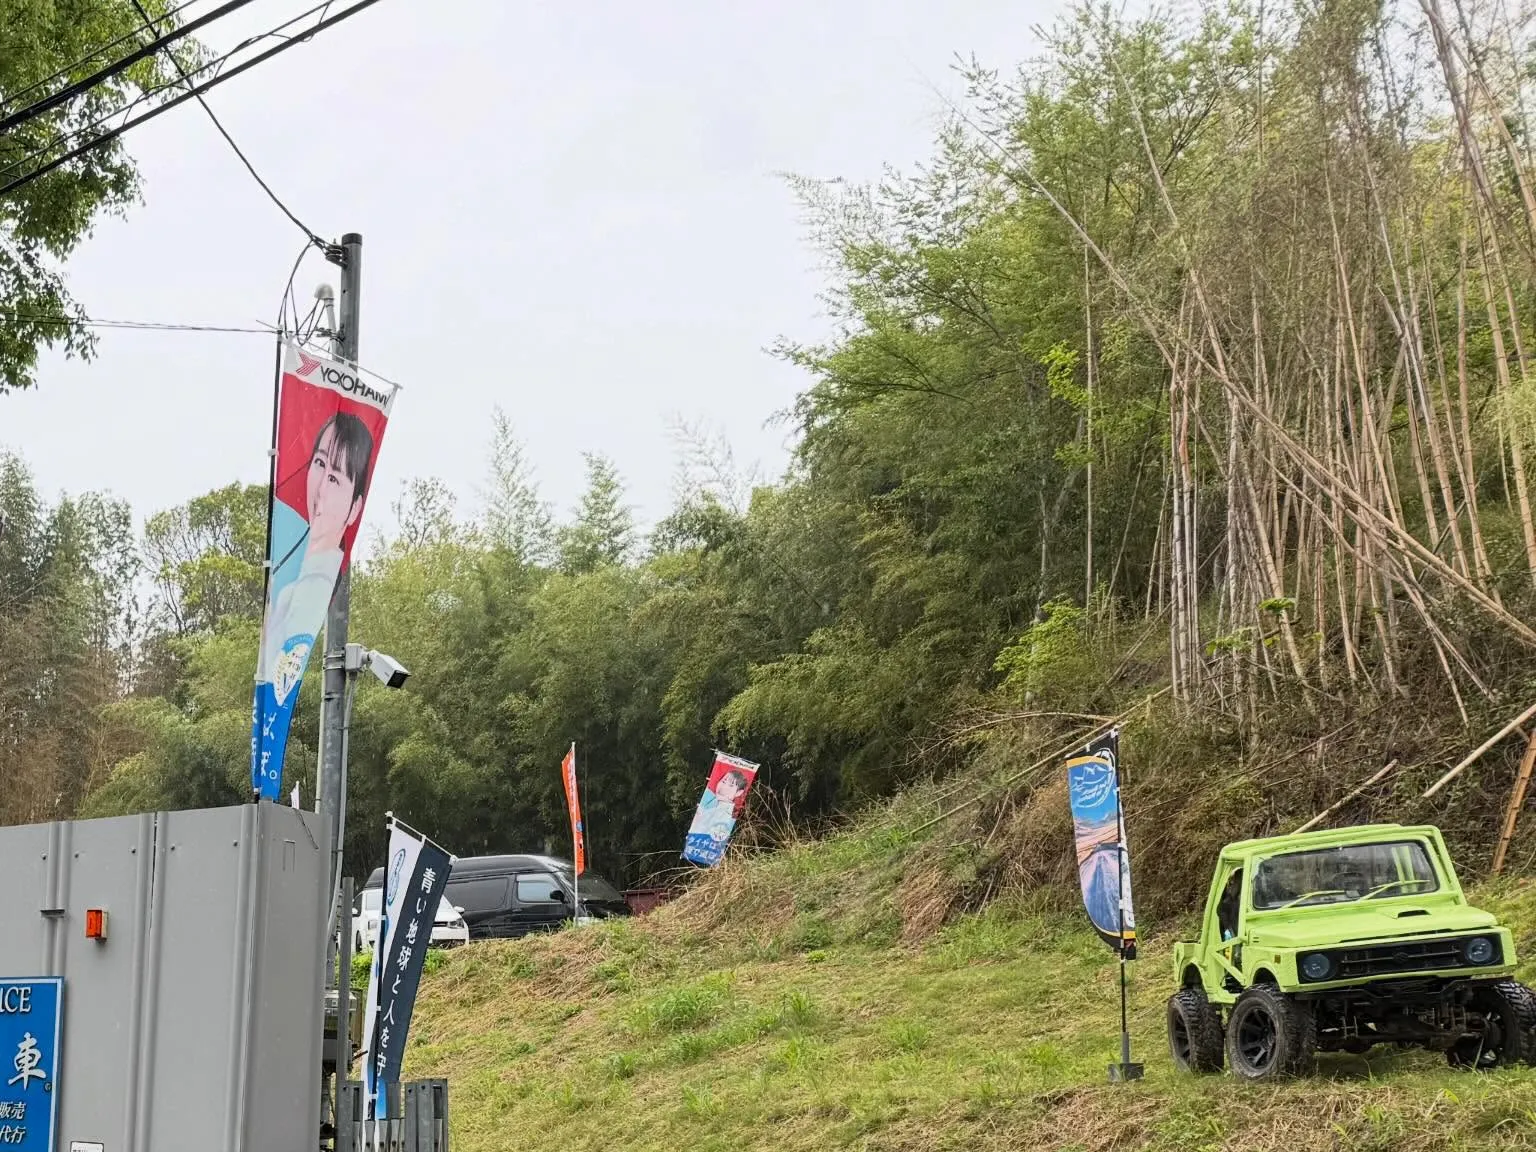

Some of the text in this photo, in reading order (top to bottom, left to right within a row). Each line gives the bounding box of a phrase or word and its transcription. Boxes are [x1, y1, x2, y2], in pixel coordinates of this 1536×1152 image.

[376, 867, 437, 1080] 青い地球と人を守
